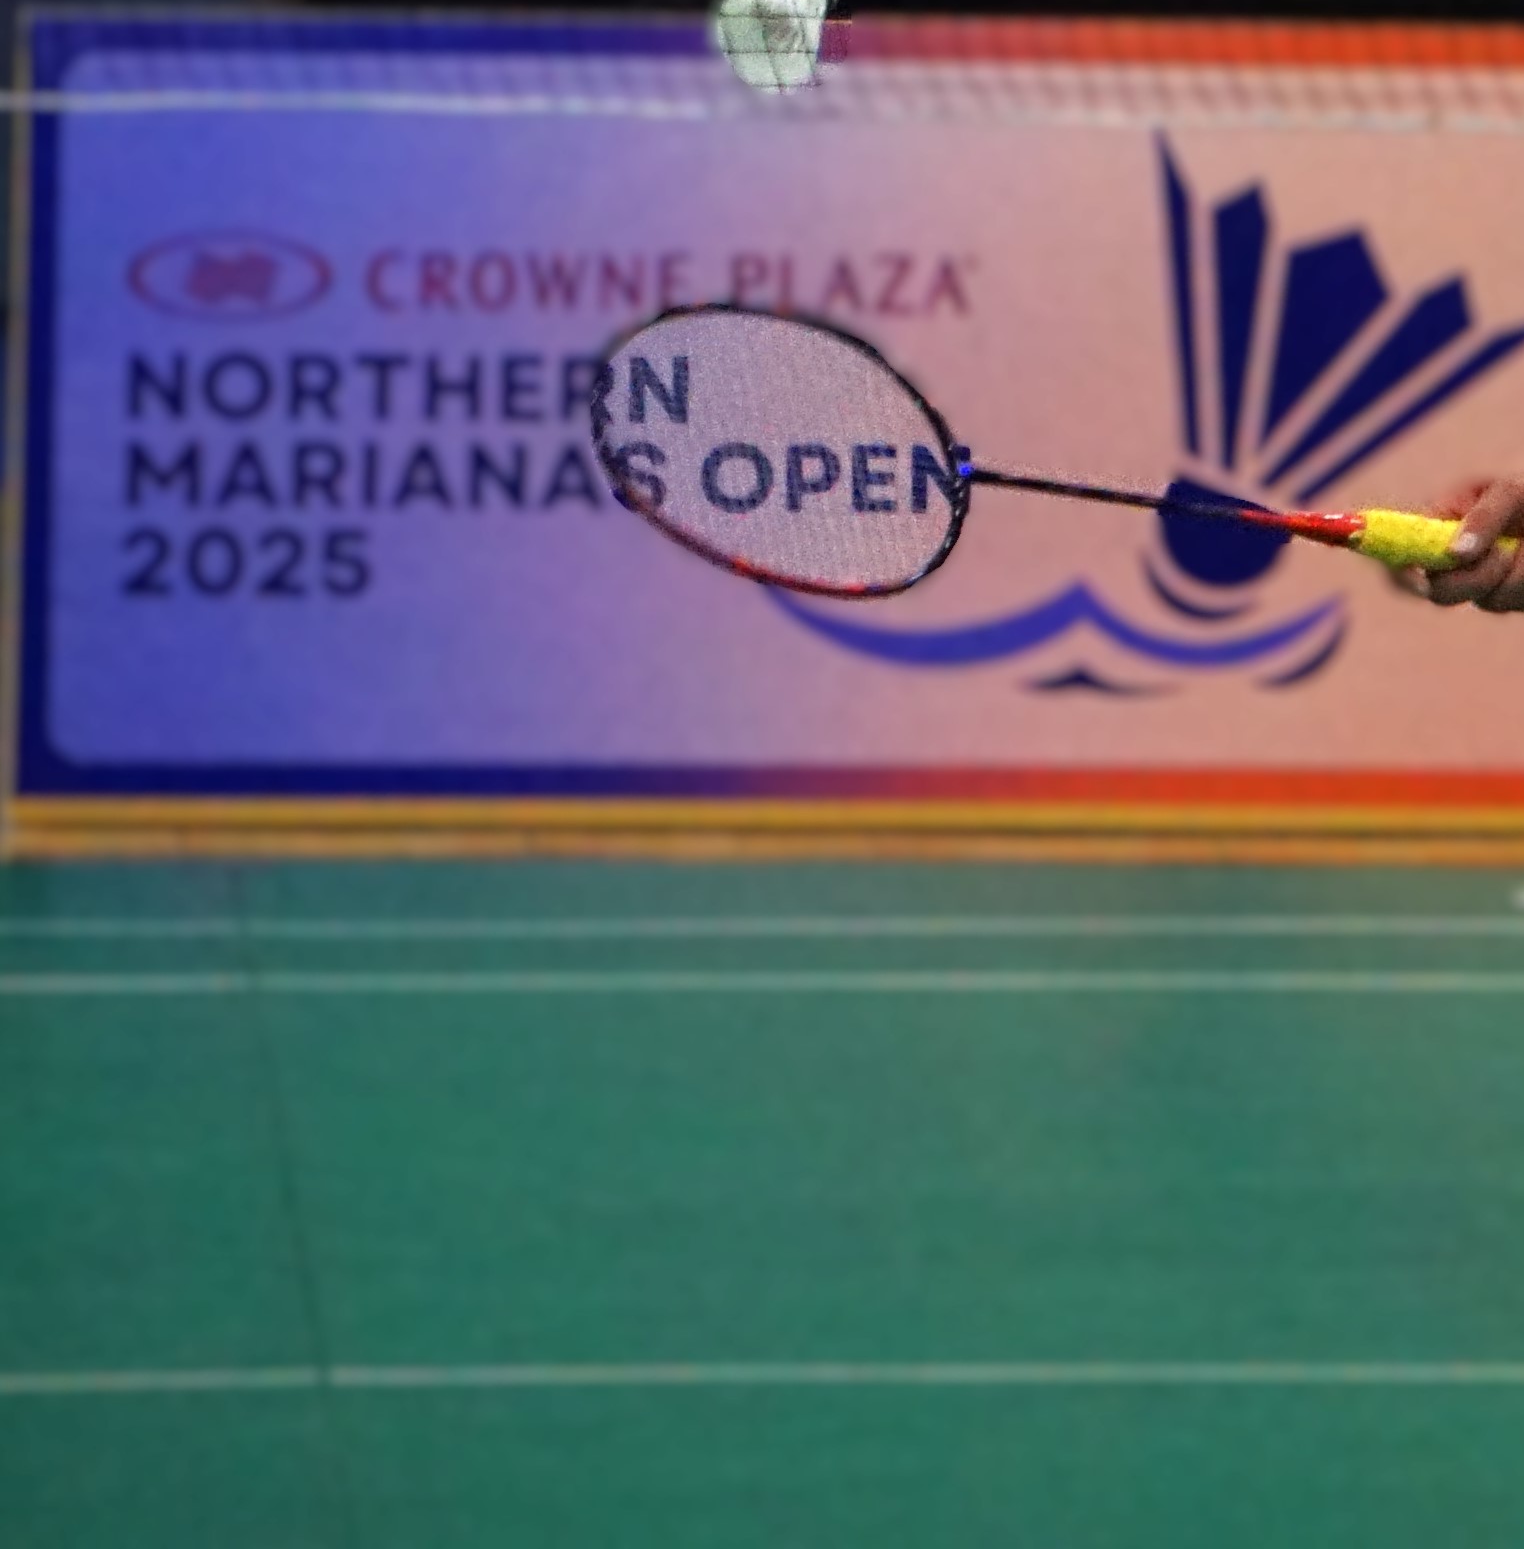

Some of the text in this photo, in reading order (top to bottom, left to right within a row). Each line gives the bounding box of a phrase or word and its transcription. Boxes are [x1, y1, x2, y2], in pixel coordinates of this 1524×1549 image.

[364, 251, 697, 312] CROWNE
[126, 352, 691, 425] NORTHERN
[123, 440, 971, 514] MARIANAS OPEN
[121, 528, 371, 598] 2025
